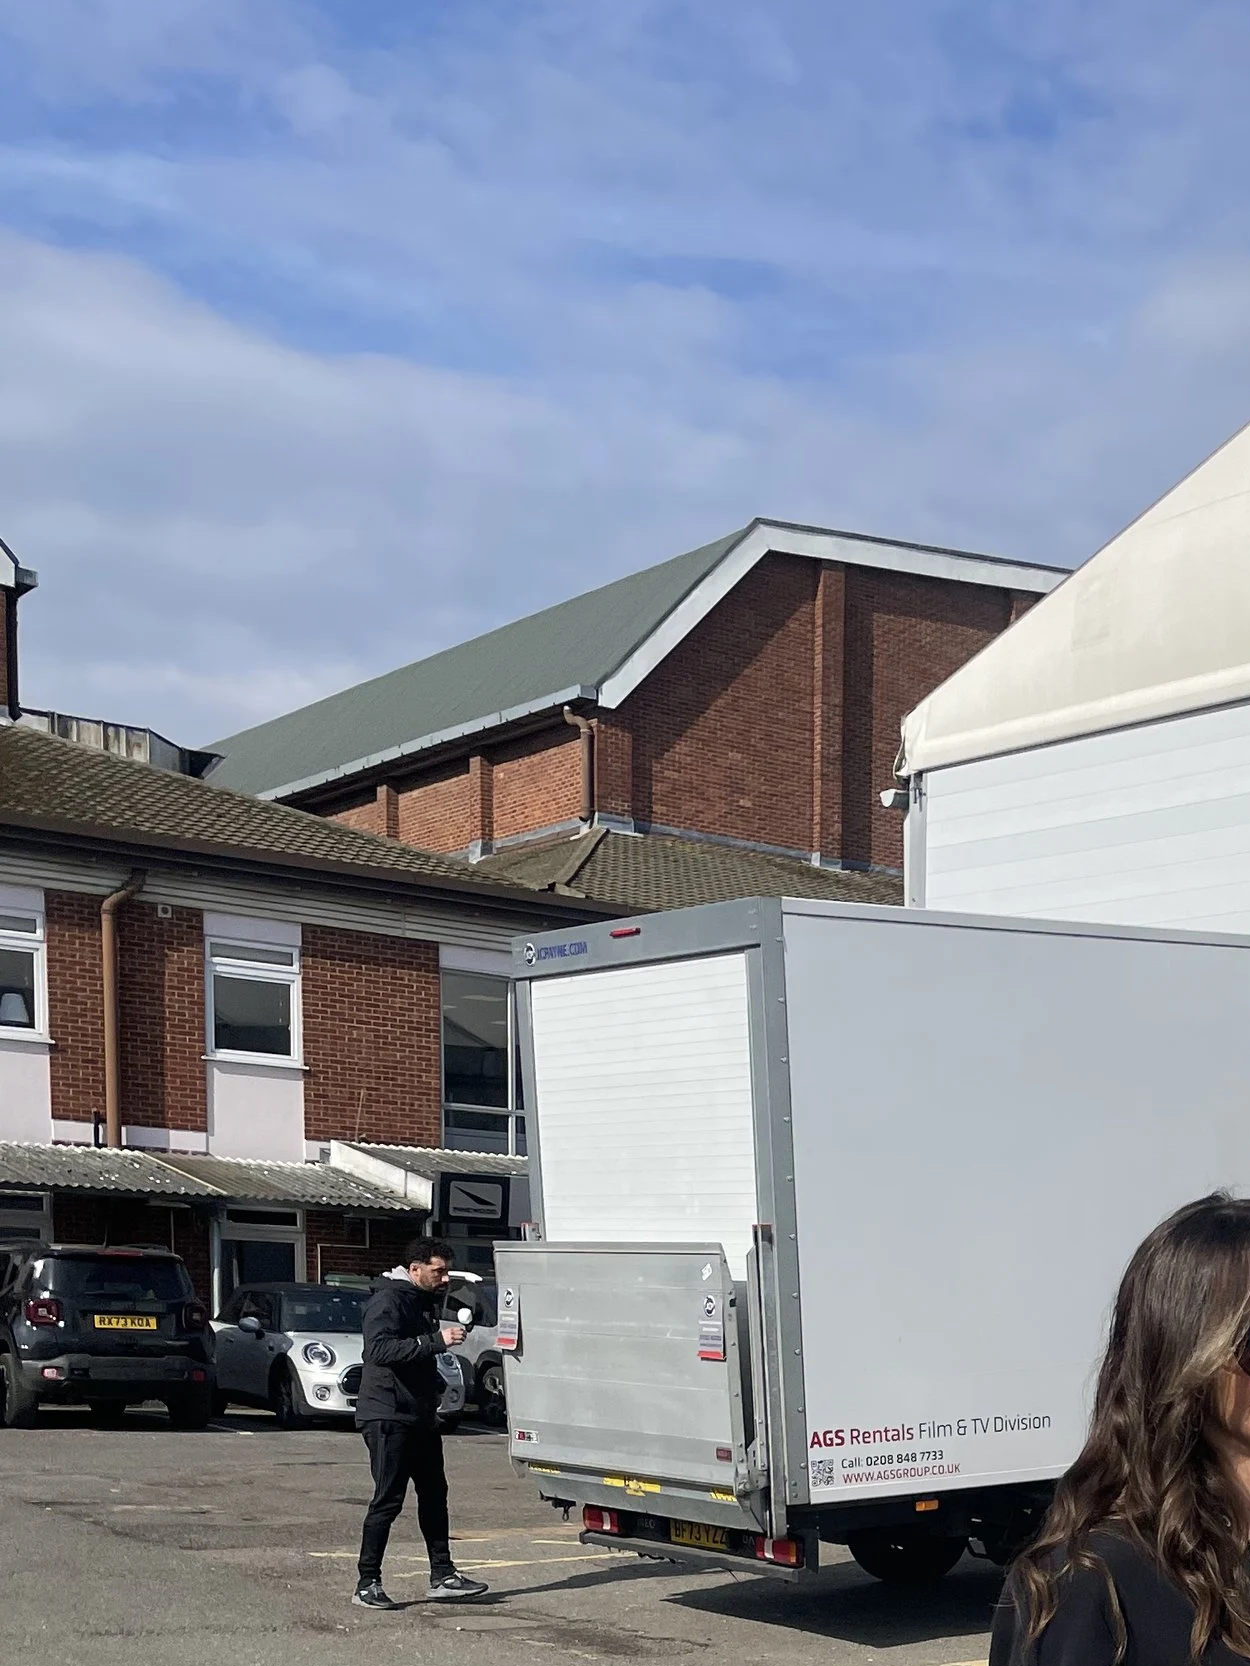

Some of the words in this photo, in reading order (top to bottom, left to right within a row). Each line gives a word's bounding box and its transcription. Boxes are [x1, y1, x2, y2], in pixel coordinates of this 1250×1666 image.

[810, 1429, 845, 1449] AGS
[850, 1423, 914, 1445] Rentals
[919, 1420, 953, 1440] Film
[957, 1419, 968, 1436] &
[971, 1417, 990, 1435] TV
[993, 1413, 1051, 1433] Division
[841, 1457, 864, 1469] Call:
[866, 1454, 894, 1467] 0208
[896, 1452, 918, 1464] 848
[919, 1449, 944, 1462] 7733
[842, 1463, 961, 1484] WWW.AGSGROUP.CO.UK
